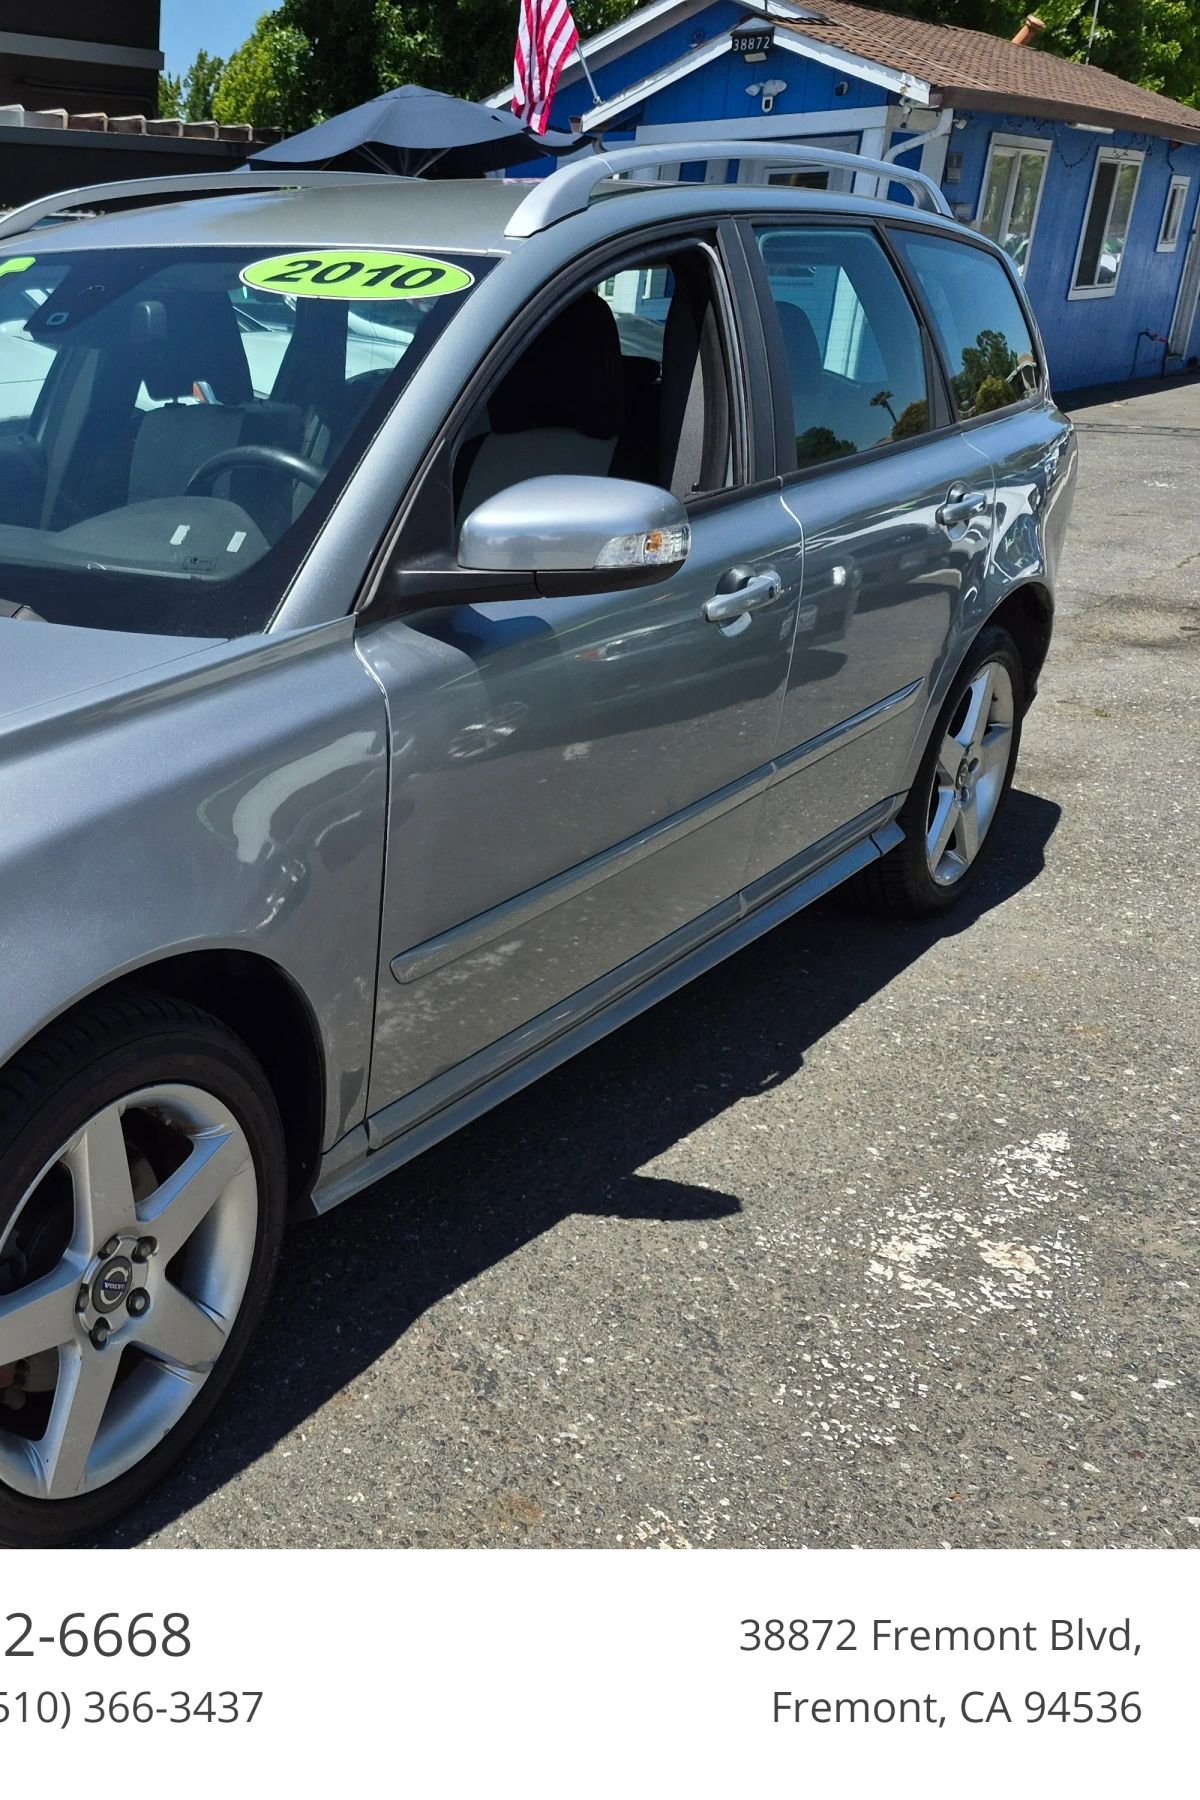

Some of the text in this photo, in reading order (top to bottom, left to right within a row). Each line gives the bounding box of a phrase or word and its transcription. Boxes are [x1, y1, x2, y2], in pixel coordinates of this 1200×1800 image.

[733, 36, 770, 51] 38872
[262, 260, 447, 289] 2010
[104, 1281, 126, 1292] VOLVO
